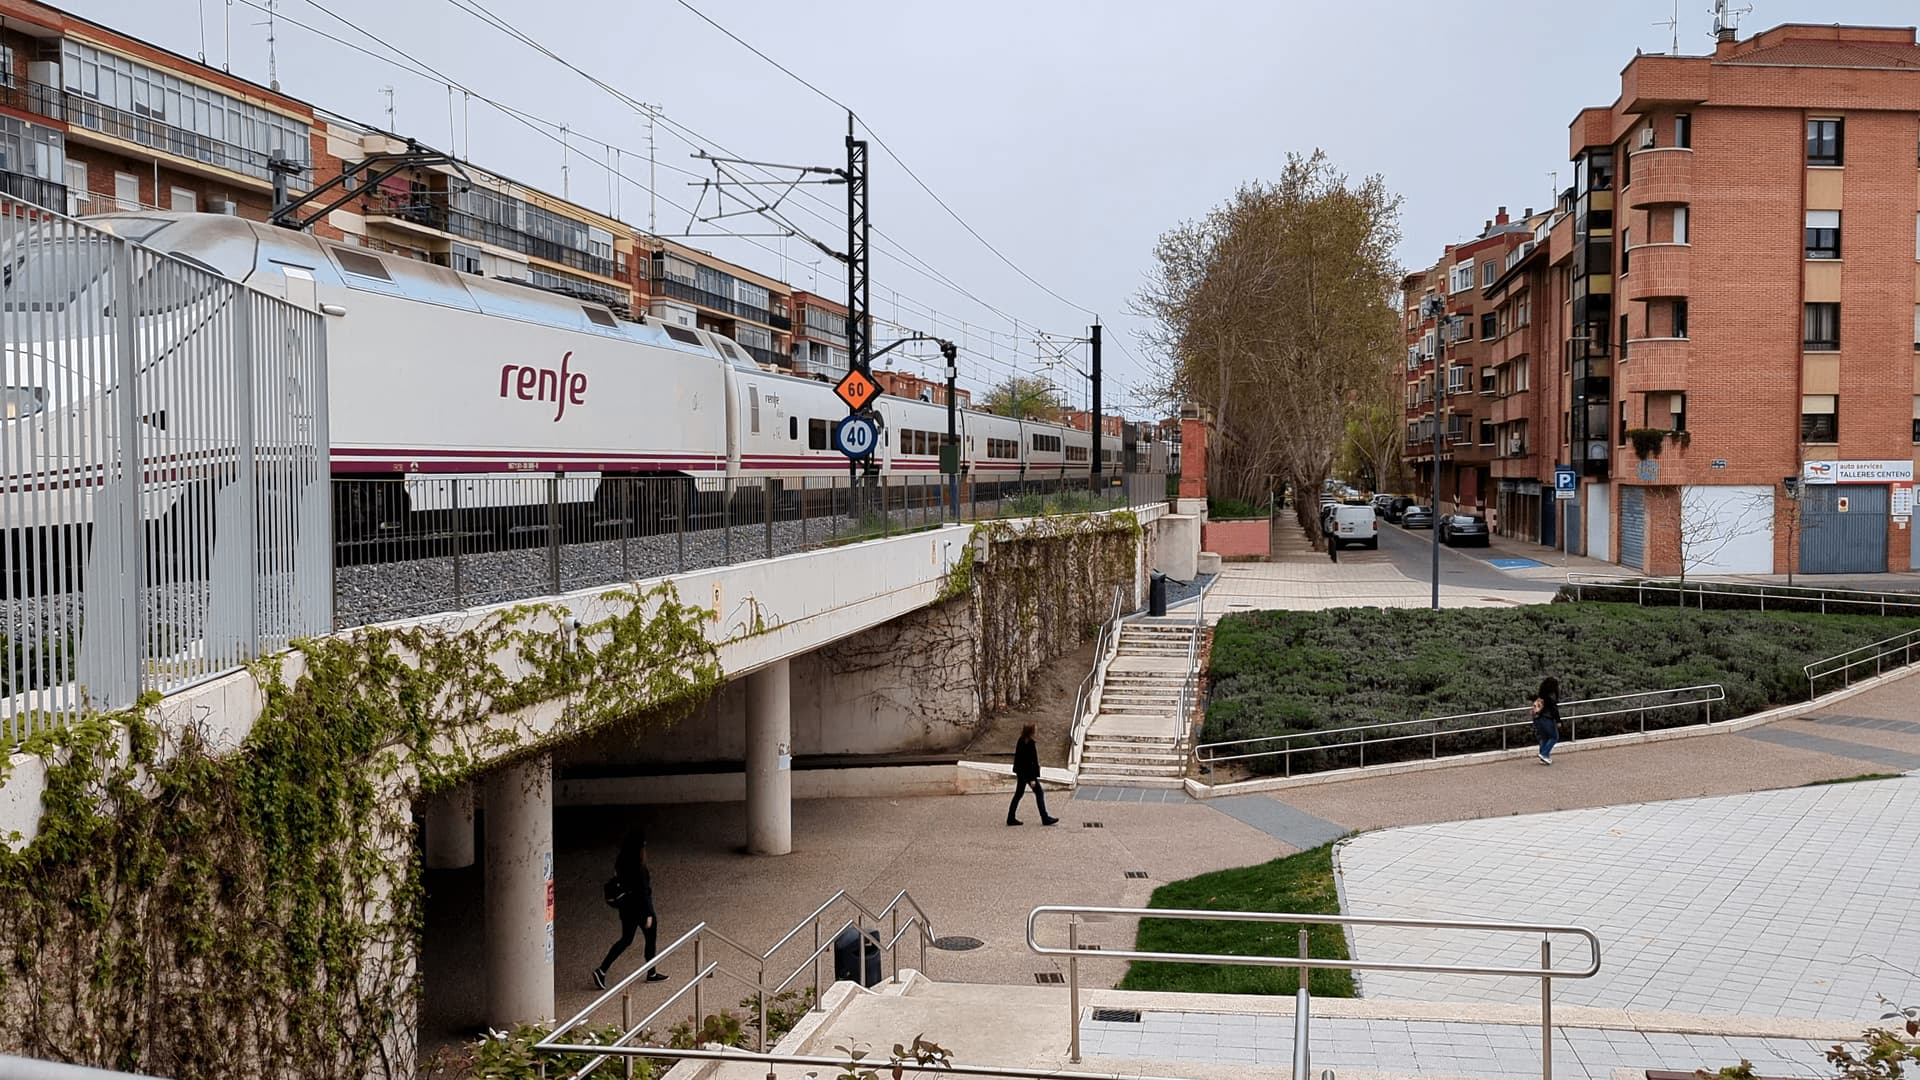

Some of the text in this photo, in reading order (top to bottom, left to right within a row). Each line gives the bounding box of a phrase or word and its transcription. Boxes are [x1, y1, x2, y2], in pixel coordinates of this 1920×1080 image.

[500, 351, 587, 422] renfe
[847, 381, 865, 397] 60
[765, 391, 780, 408] renfe
[847, 426, 866, 446] 40
[1559, 473, 1571, 487] P
[1840, 471, 1875, 479] TALLERES
[1877, 471, 1911, 479] CENTENO
